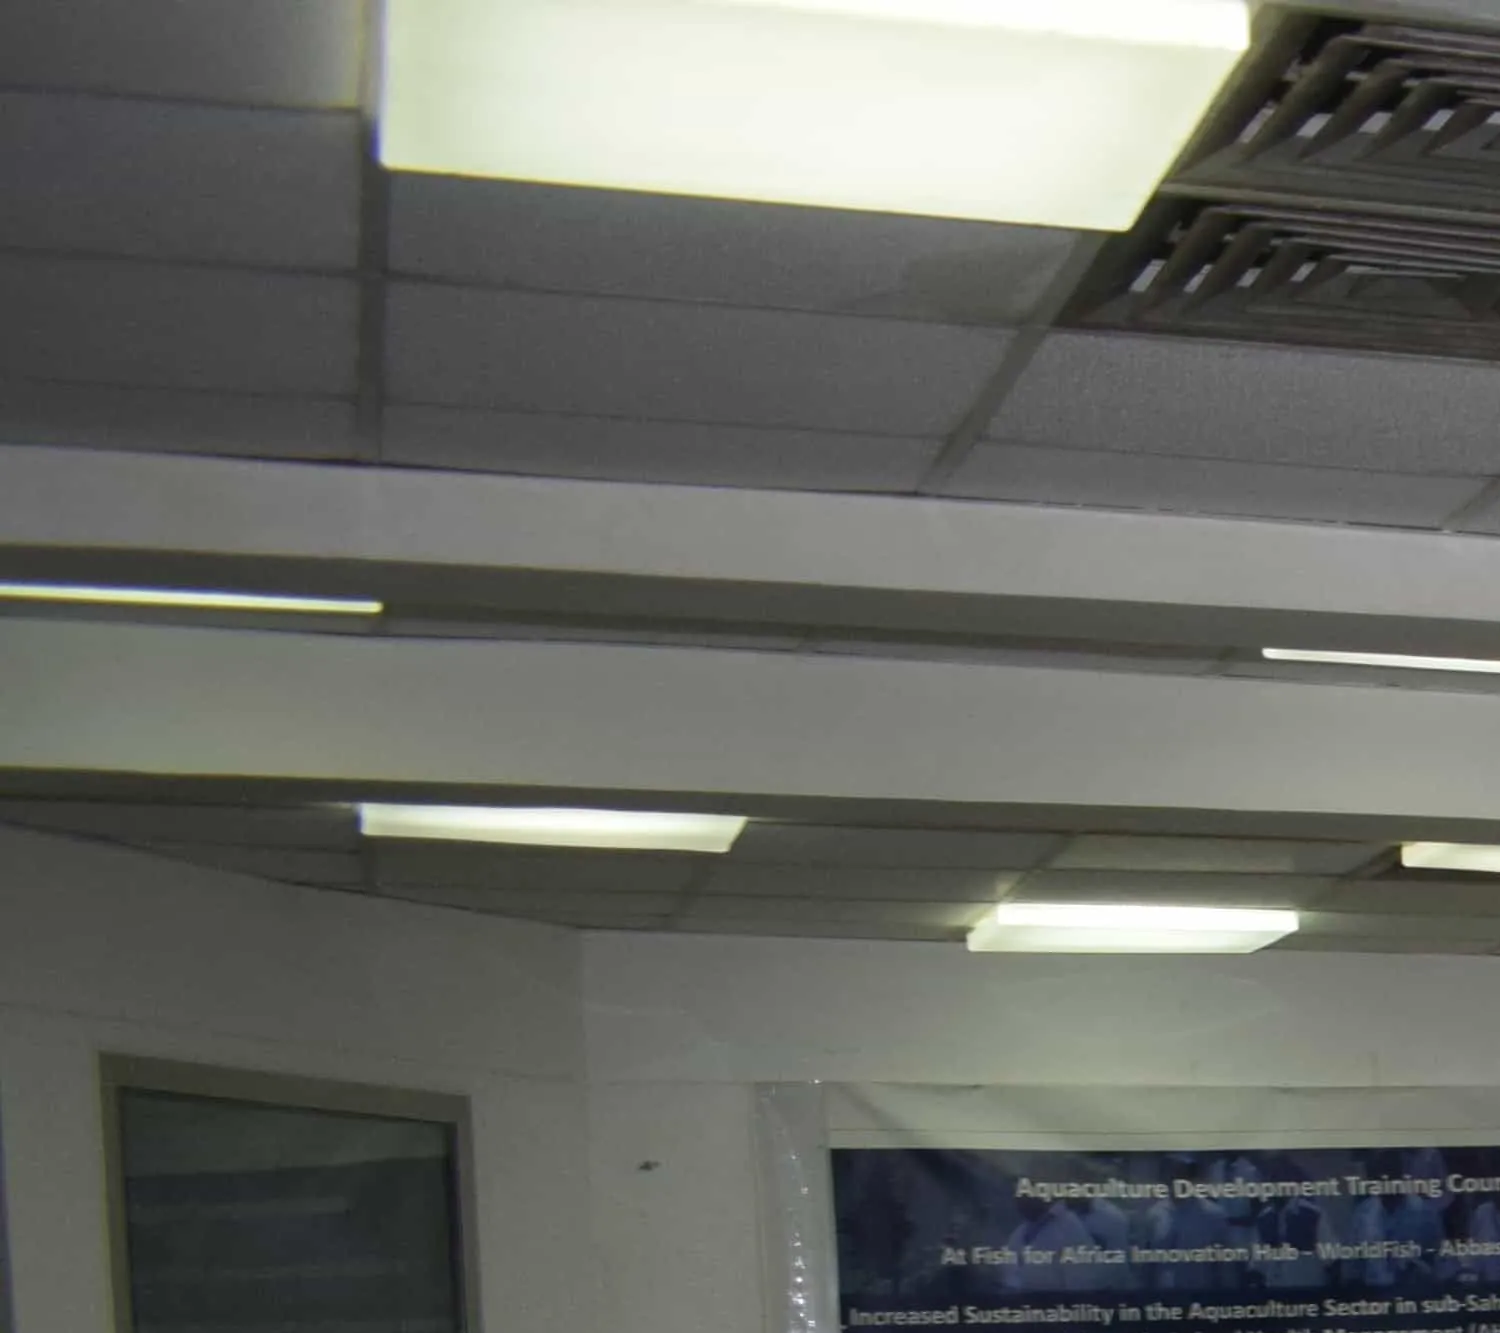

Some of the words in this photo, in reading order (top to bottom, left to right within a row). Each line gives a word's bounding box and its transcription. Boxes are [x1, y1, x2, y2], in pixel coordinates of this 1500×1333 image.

[1016, 1177, 1169, 1202] Aquaculture
[1173, 1175, 1341, 1201] Development
[1346, 1174, 1442, 1199] Training
[941, 1248, 967, 1266] At
[972, 1247, 1018, 1266] Fish
[1023, 1247, 1056, 1265] for
[1060, 1246, 1126, 1264] Africa
[1132, 1244, 1249, 1263] Innovation
[1252, 1242, 1299, 1261] Hub
[1317, 1240, 1421, 1260] WorldFish
[849, 1306, 959, 1327] Increased
[964, 1303, 1115, 1330] Sustainability
[1119, 1303, 1141, 1322] in
[1145, 1302, 1183, 1322] the
[1188, 1299, 1319, 1323] Aquaculture
[1323, 1298, 1391, 1318] Sector
[1395, 1296, 1417, 1315] in
